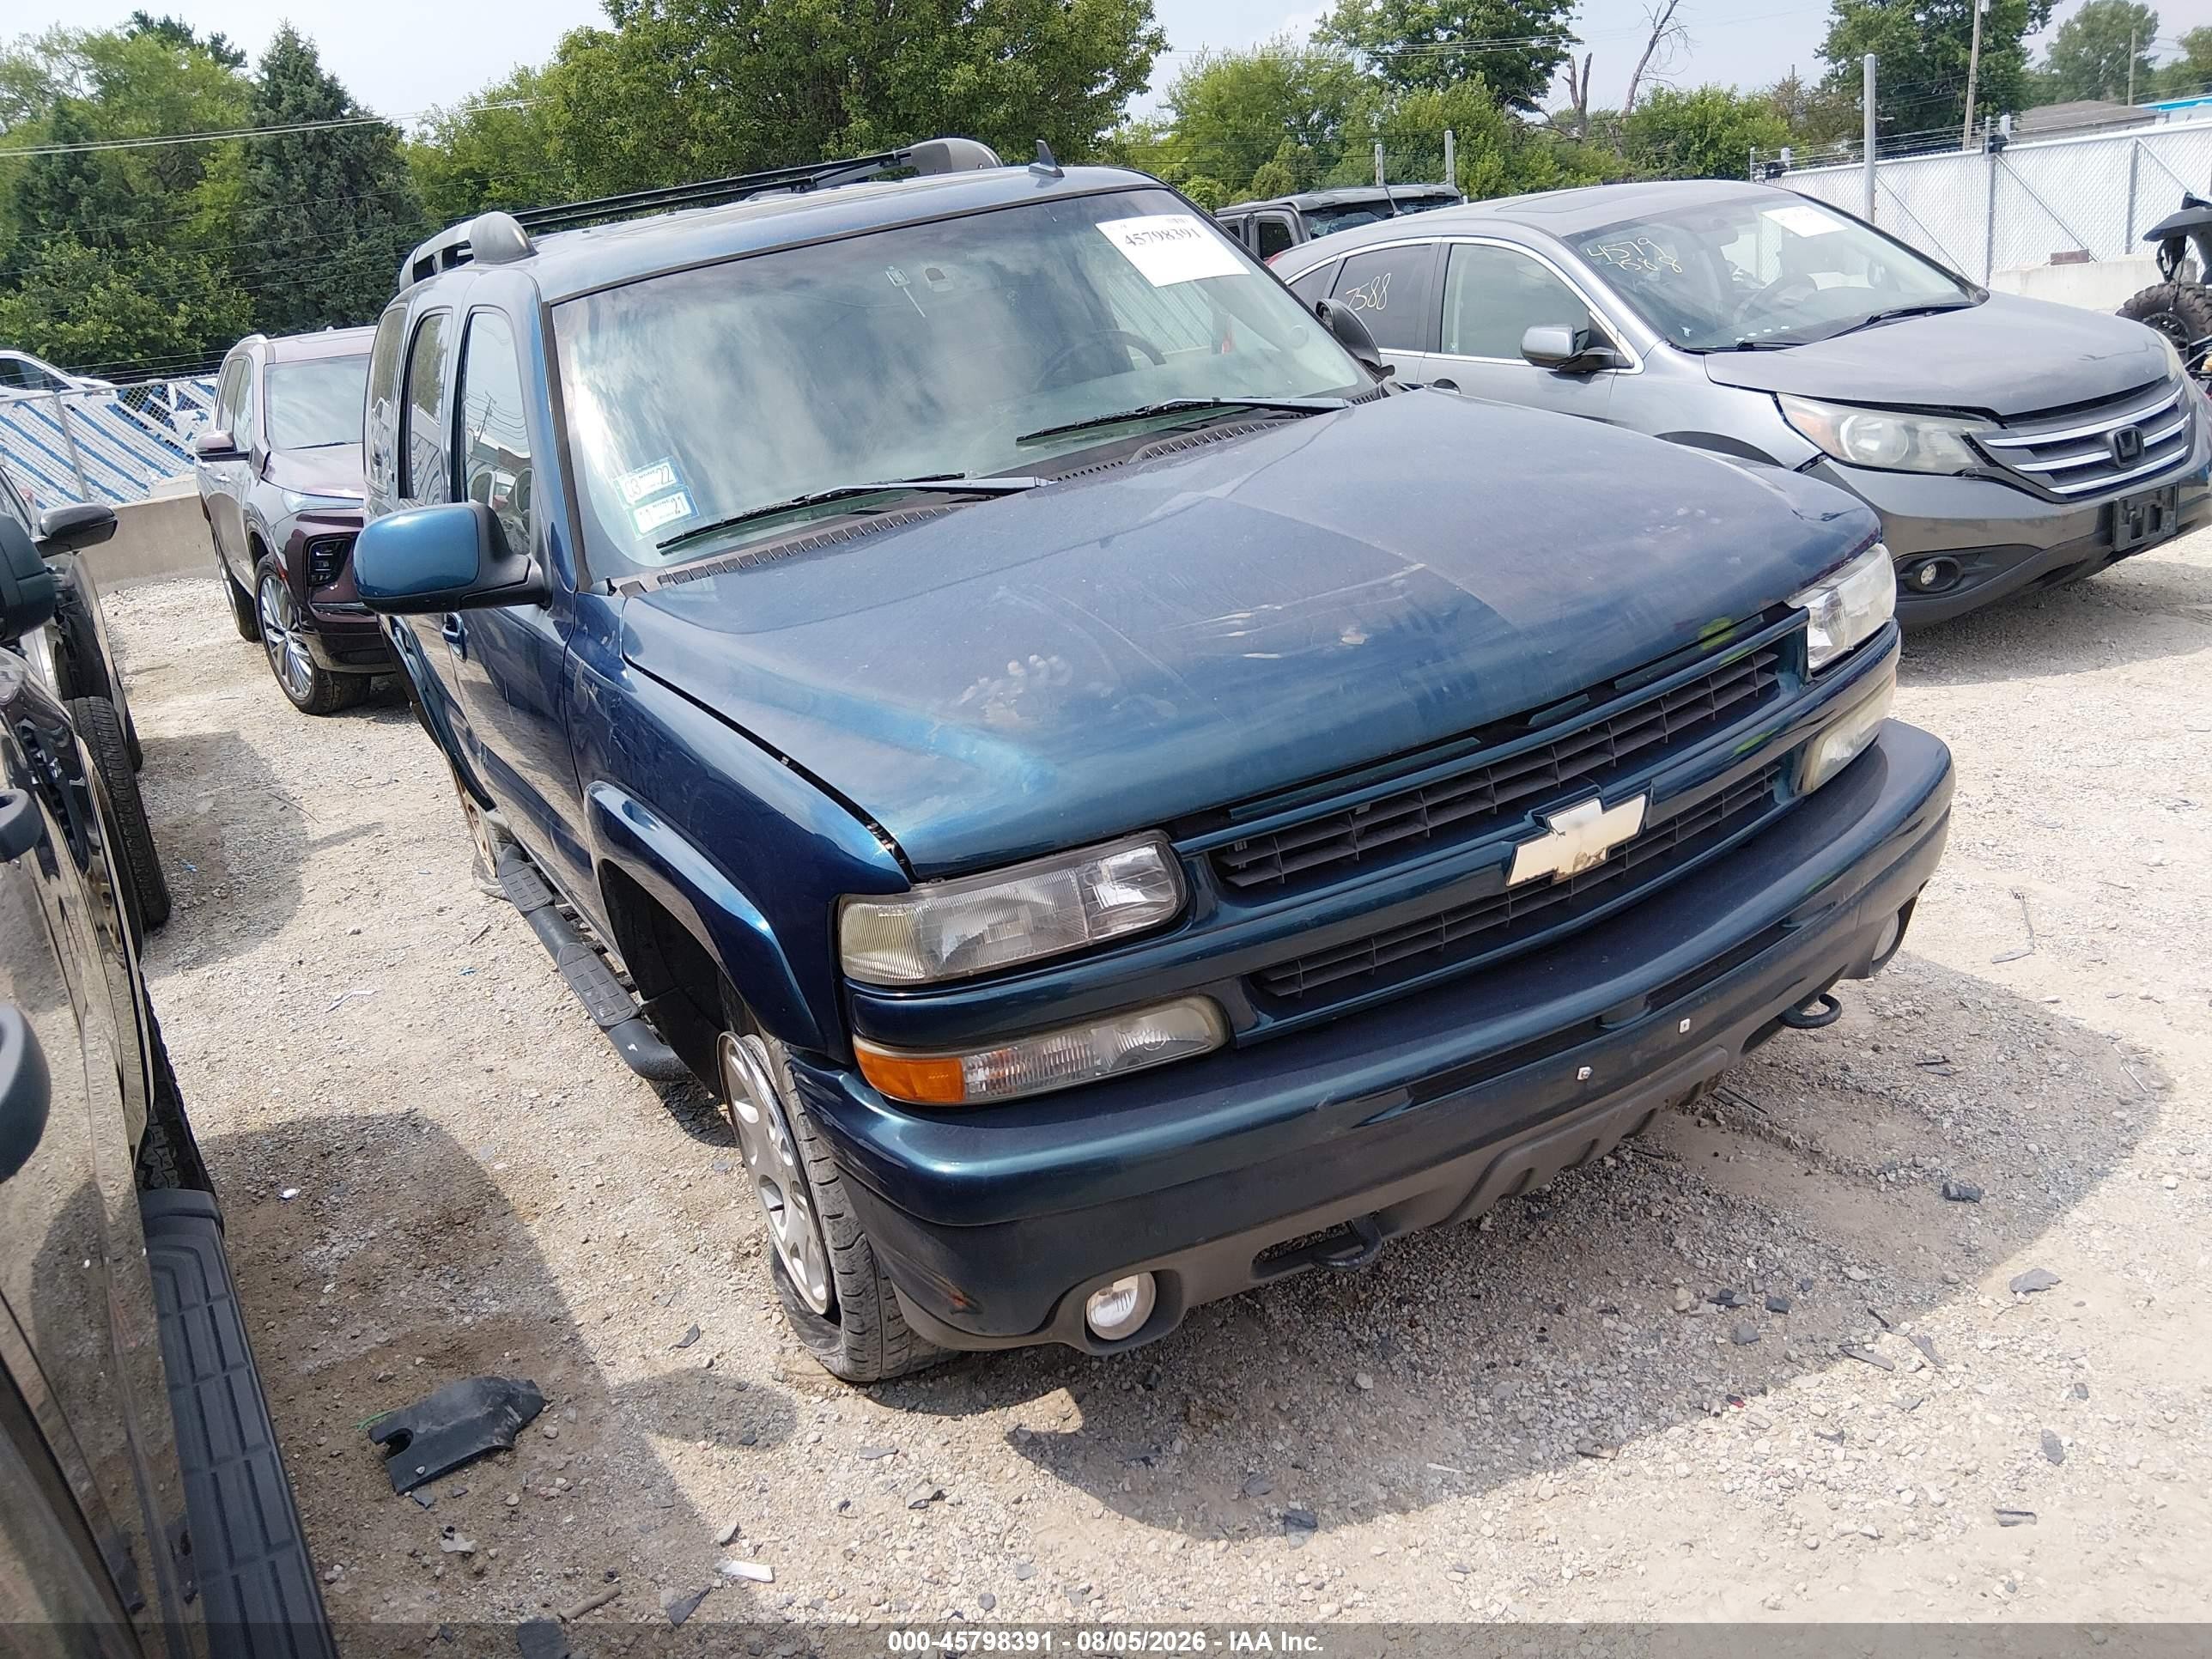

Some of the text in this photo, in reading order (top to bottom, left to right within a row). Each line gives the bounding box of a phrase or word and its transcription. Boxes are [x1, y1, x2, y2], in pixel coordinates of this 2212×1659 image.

[1125, 228, 1201, 246] 45798391
[1346, 272, 1391, 311] 7588
[656, 465, 674, 485] 22
